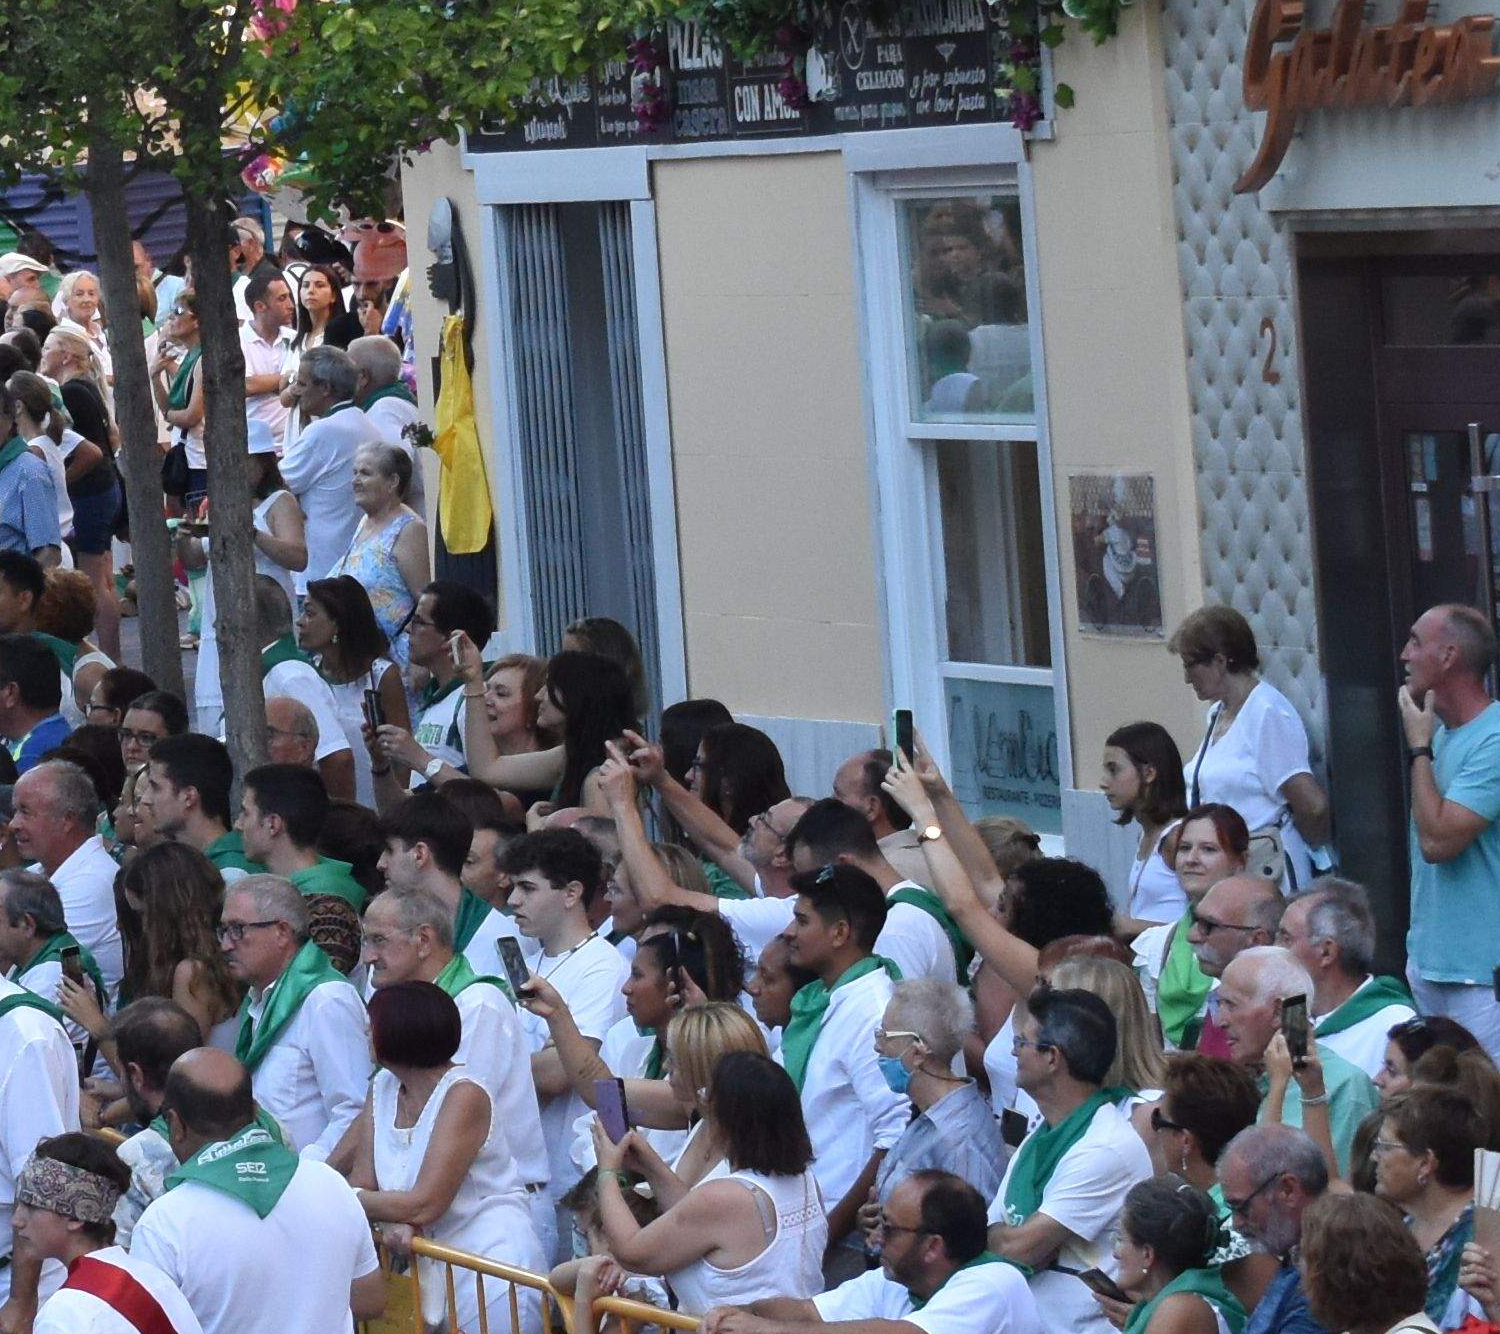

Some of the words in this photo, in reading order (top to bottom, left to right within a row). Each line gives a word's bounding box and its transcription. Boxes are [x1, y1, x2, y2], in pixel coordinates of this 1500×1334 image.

[856, 68, 905, 91] CELIACOS
[734, 84, 761, 123] CON
[956, 92, 986, 122] pasta
[1260, 317, 1281, 385] 2
[235, 1161, 268, 1175] SER
